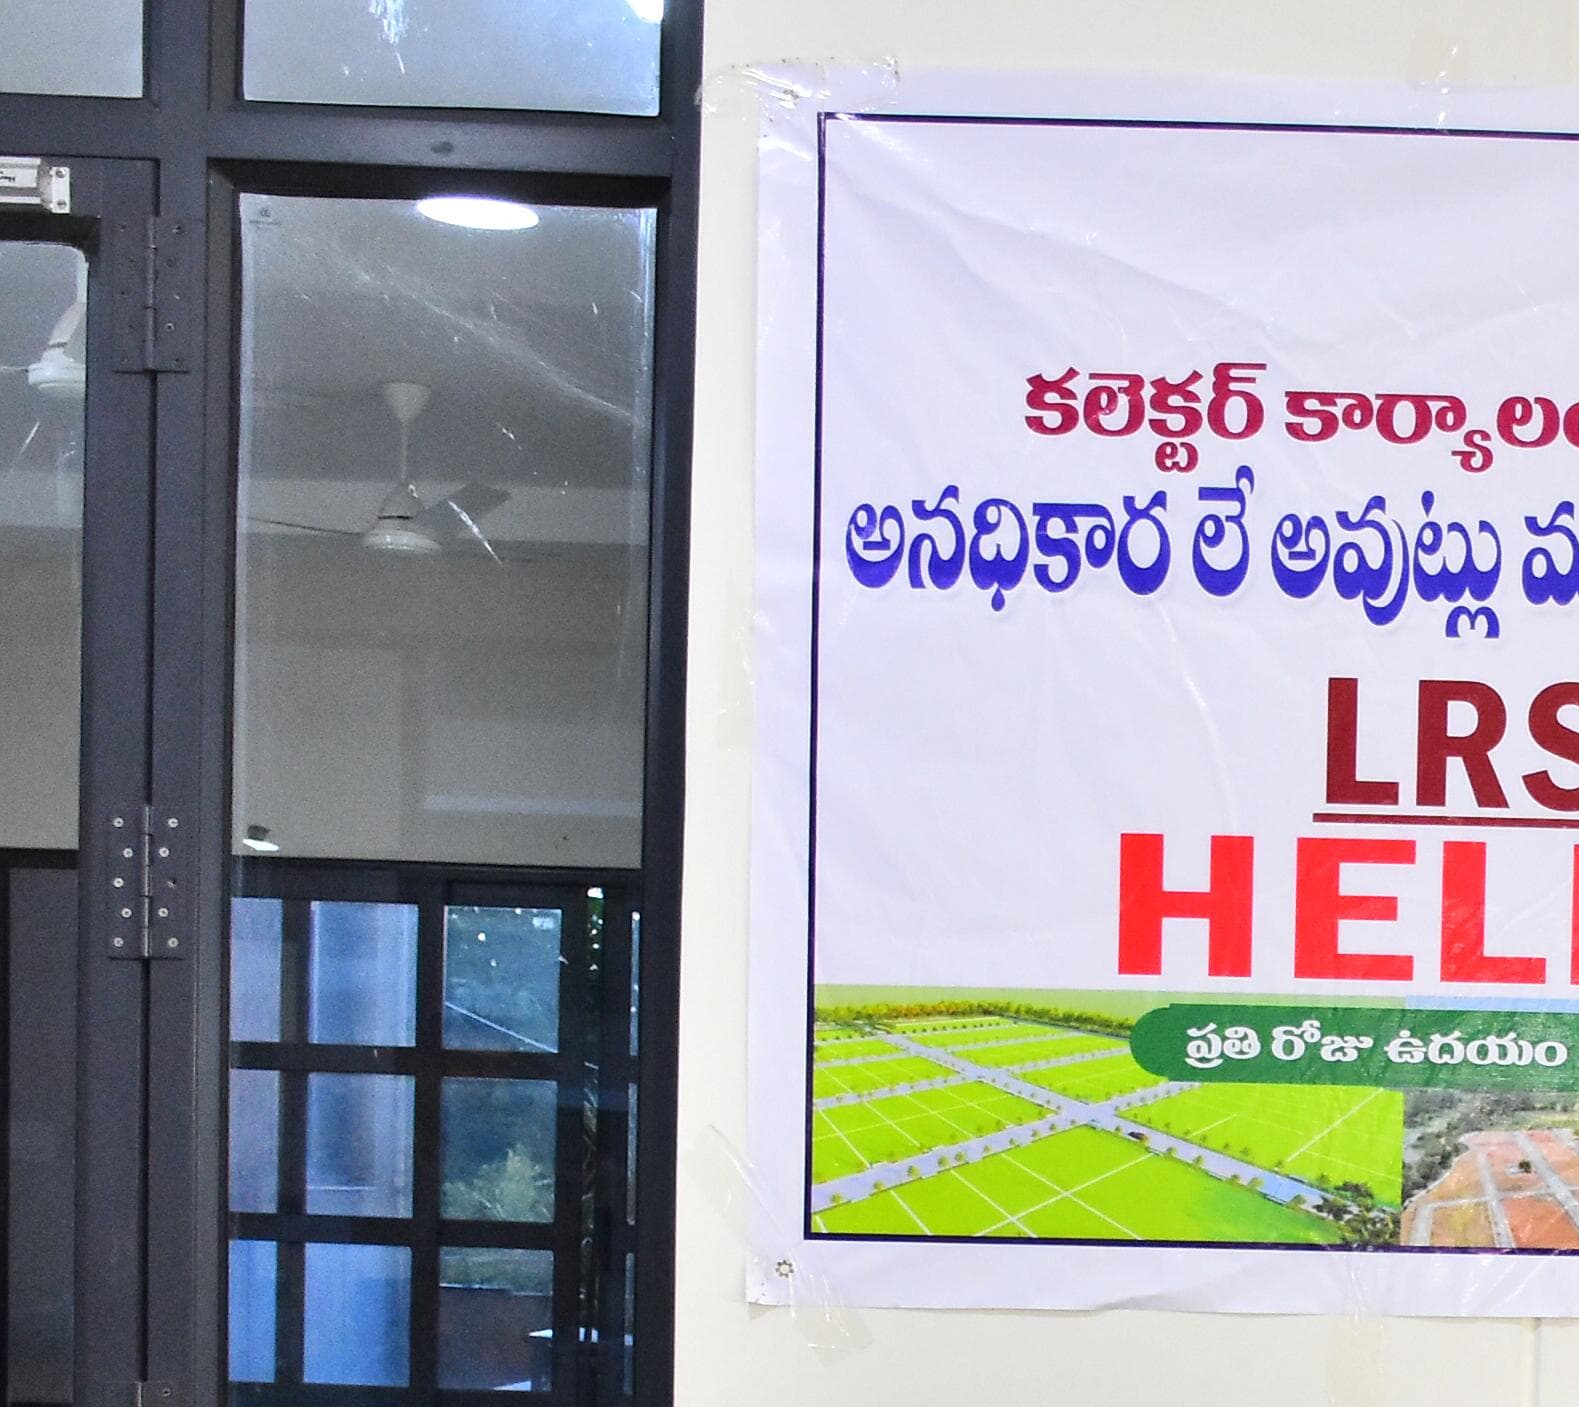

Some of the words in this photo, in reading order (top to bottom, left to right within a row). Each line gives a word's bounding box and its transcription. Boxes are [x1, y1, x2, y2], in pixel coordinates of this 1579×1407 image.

[1025, 362, 1267, 473] కలెక్టర్
[844, 483, 1173, 612] అనధికార
[1190, 464, 1256, 598] లే
[1270, 488, 1503, 640] అవుట్లు
[1184, 1022, 1261, 1068] ప్రతి
[1271, 1020, 1375, 1062] రోజు
[1384, 1029, 1568, 1067] ఉదయం
